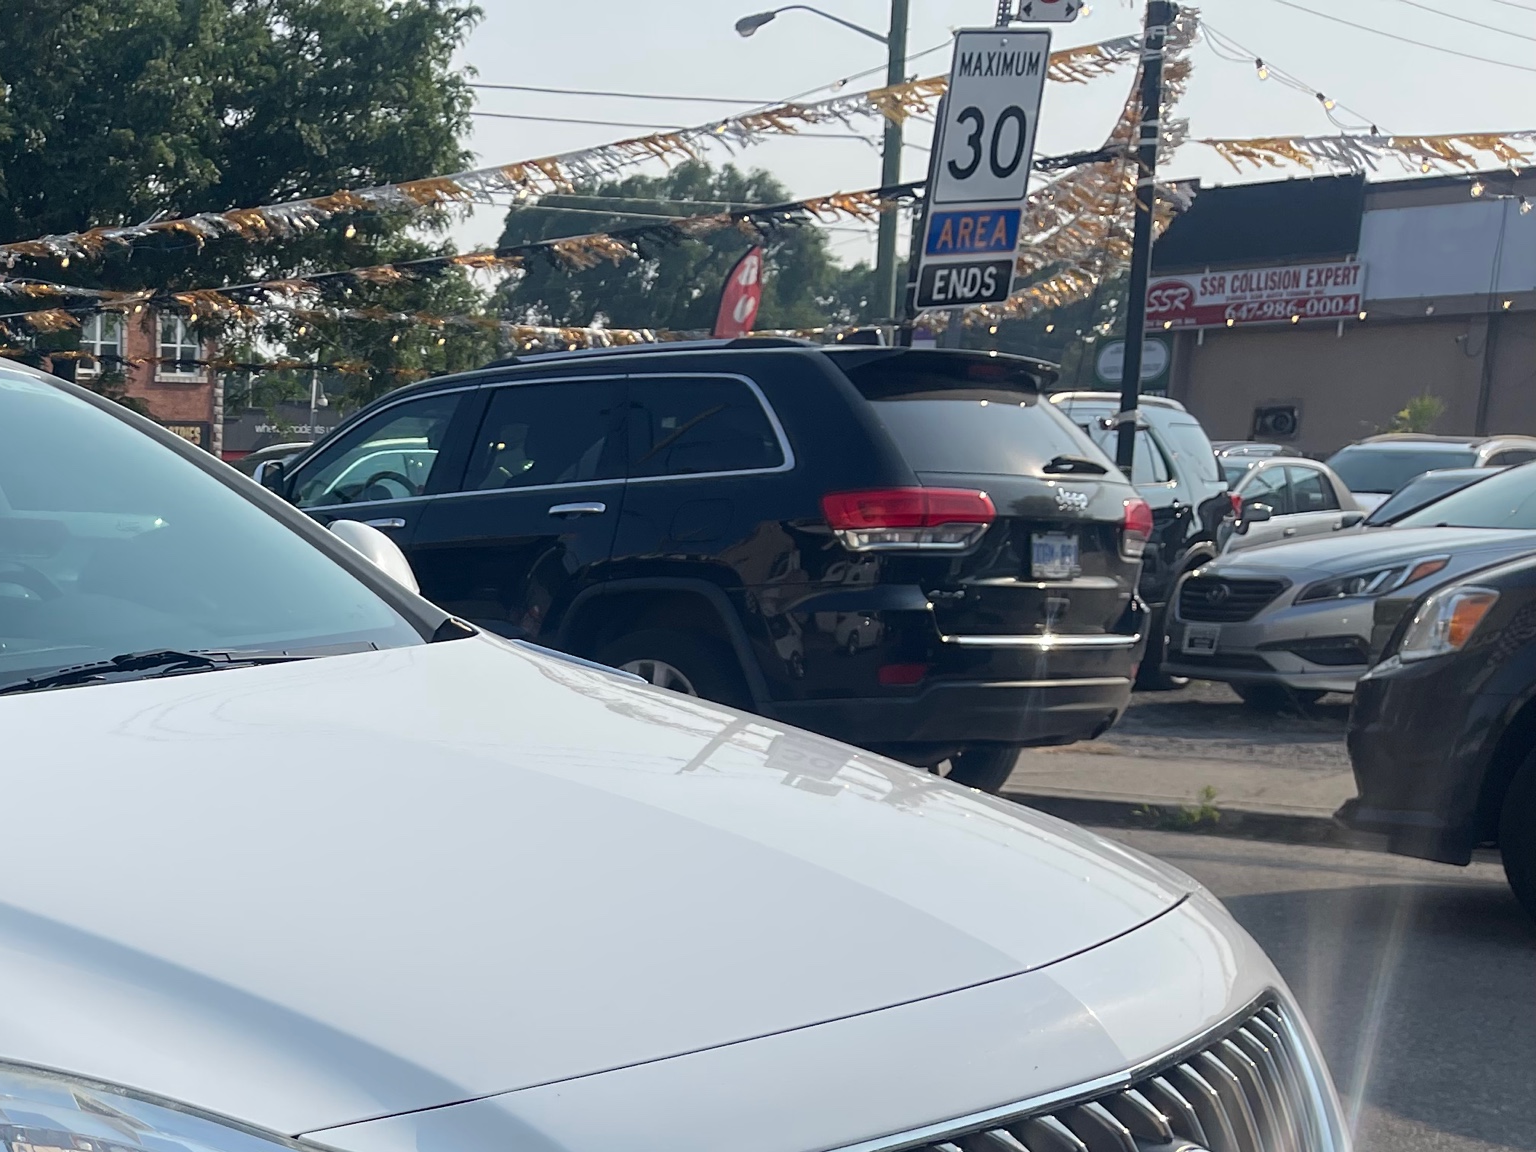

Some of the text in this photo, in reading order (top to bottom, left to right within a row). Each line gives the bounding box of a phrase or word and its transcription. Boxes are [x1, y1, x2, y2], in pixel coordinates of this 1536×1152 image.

[959, 51, 1041, 77] MAXIMUM
[947, 105, 1027, 180] 30
[935, 215, 1006, 250] AREA
[931, 266, 997, 300] ENDS
[1199, 276, 1226, 296] SSR
[1230, 269, 1300, 293] COLLISION
[1306, 265, 1360, 288] EXPERT
[1145, 287, 1190, 313] SSR
[1225, 296, 1356, 321] 647-986-0004
